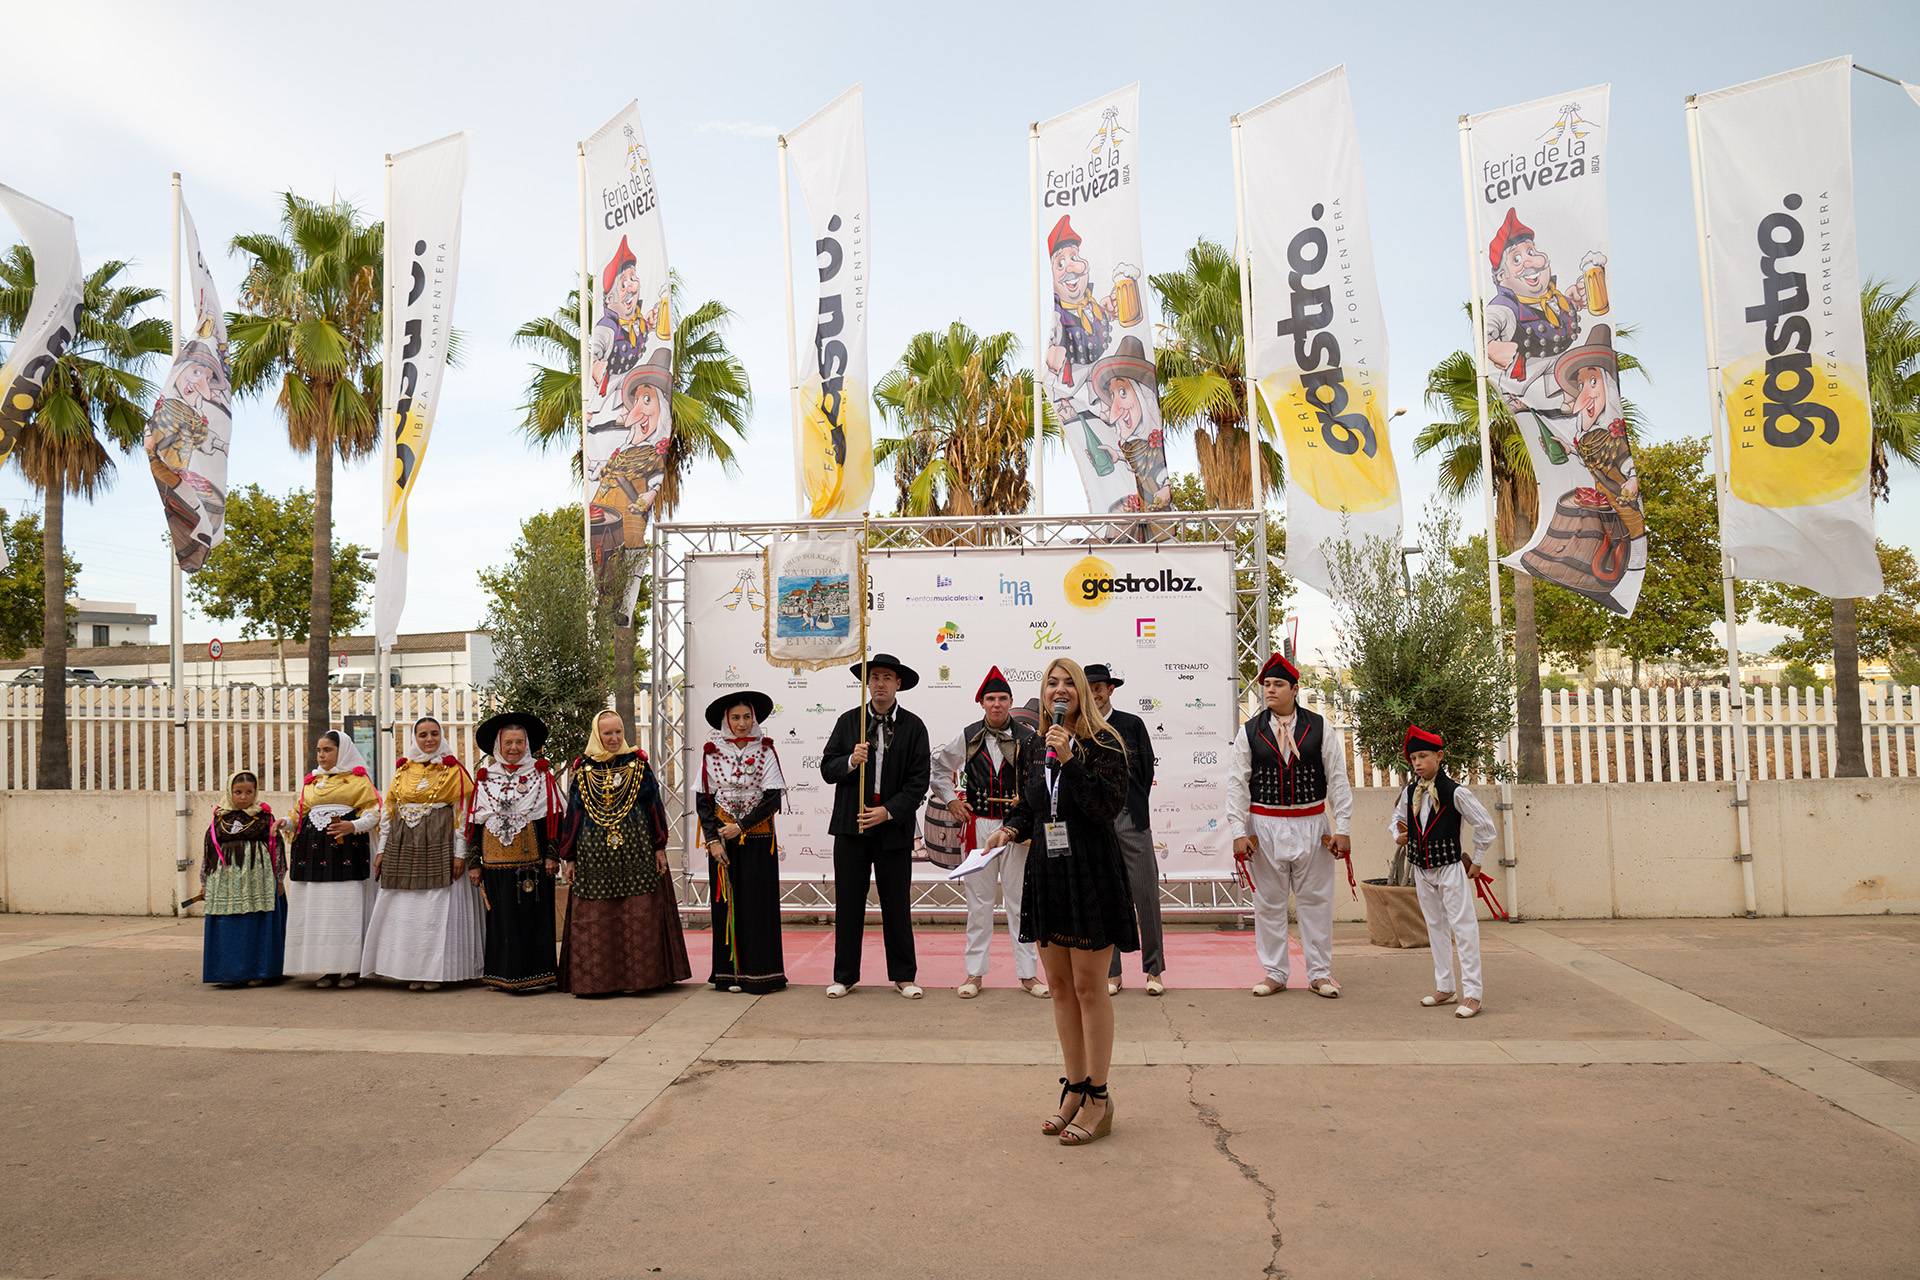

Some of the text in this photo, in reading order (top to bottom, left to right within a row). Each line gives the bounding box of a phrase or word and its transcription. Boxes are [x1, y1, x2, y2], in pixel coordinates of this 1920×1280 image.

[1046, 147, 1120, 188] feria de la
[1122, 164, 1130, 185] IBIZA
[1483, 138, 1585, 182] feria de la
[1484, 157, 1585, 204] cerveza
[1591, 155, 1600, 174] IBIZA
[602, 165, 652, 210] feria de la
[1044, 168, 1119, 208] cerveza
[1820, 191, 1833, 316] FORMENTERA
[1332, 198, 1373, 407] BIZA Y FORMENTERA
[1744, 193, 1840, 449] gastro.
[1277, 202, 1378, 459] gastro.
[1827, 350, 1838, 397] IBIZA
[412, 390, 429, 438] IBIZA
[1742, 379, 1755, 449] FERIA
[877, 592, 885, 611] IBIZA
[786, 637, 842, 646] EIVISSA
[1003, 670, 1043, 681] MAMBO
[802, 761, 821, 769] FICU
